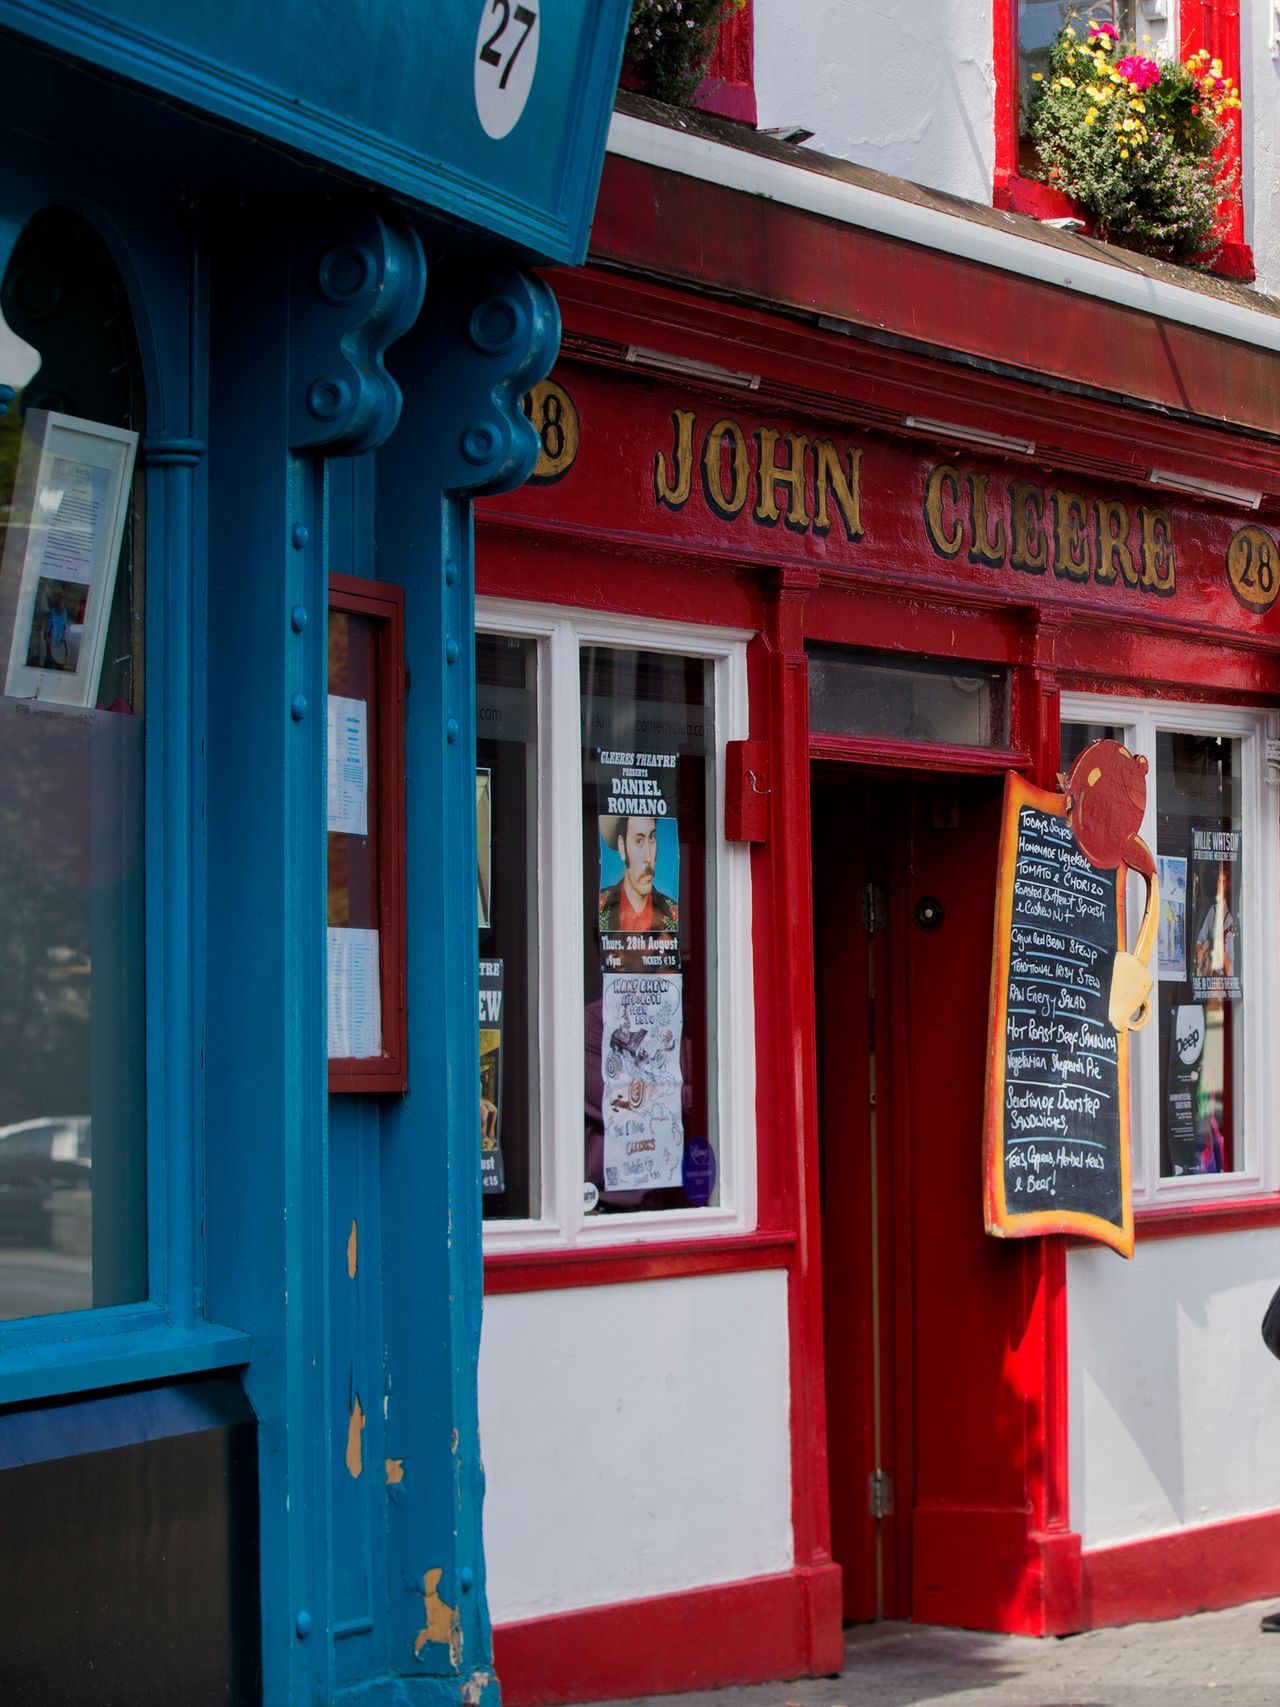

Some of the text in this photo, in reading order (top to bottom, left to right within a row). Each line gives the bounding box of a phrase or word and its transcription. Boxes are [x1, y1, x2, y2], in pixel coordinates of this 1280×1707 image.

[479, 0, 537, 90] 27
[524, 391, 566, 459] 8
[655, 408, 1274, 599] JOHN CLEERE 28
[600, 751, 676, 768] CLEERES THEATRE
[622, 767, 649, 778] PRESENTS
[611, 778, 662, 797] DANIEL
[607, 797, 668, 815] ROMANO
[1212, 832, 1239, 852] WATSON
[1016, 860, 1051, 880] TOMATO
[602, 935, 678, 954] Thurs. 28th August
[642, 956, 663, 966] TICKETS
[639, 979, 670, 994] CHEW
[1027, 985, 1057, 1019] Energy
[1058, 988, 1086, 1010] SALAD
[1086, 1057, 1102, 1080] Pie
